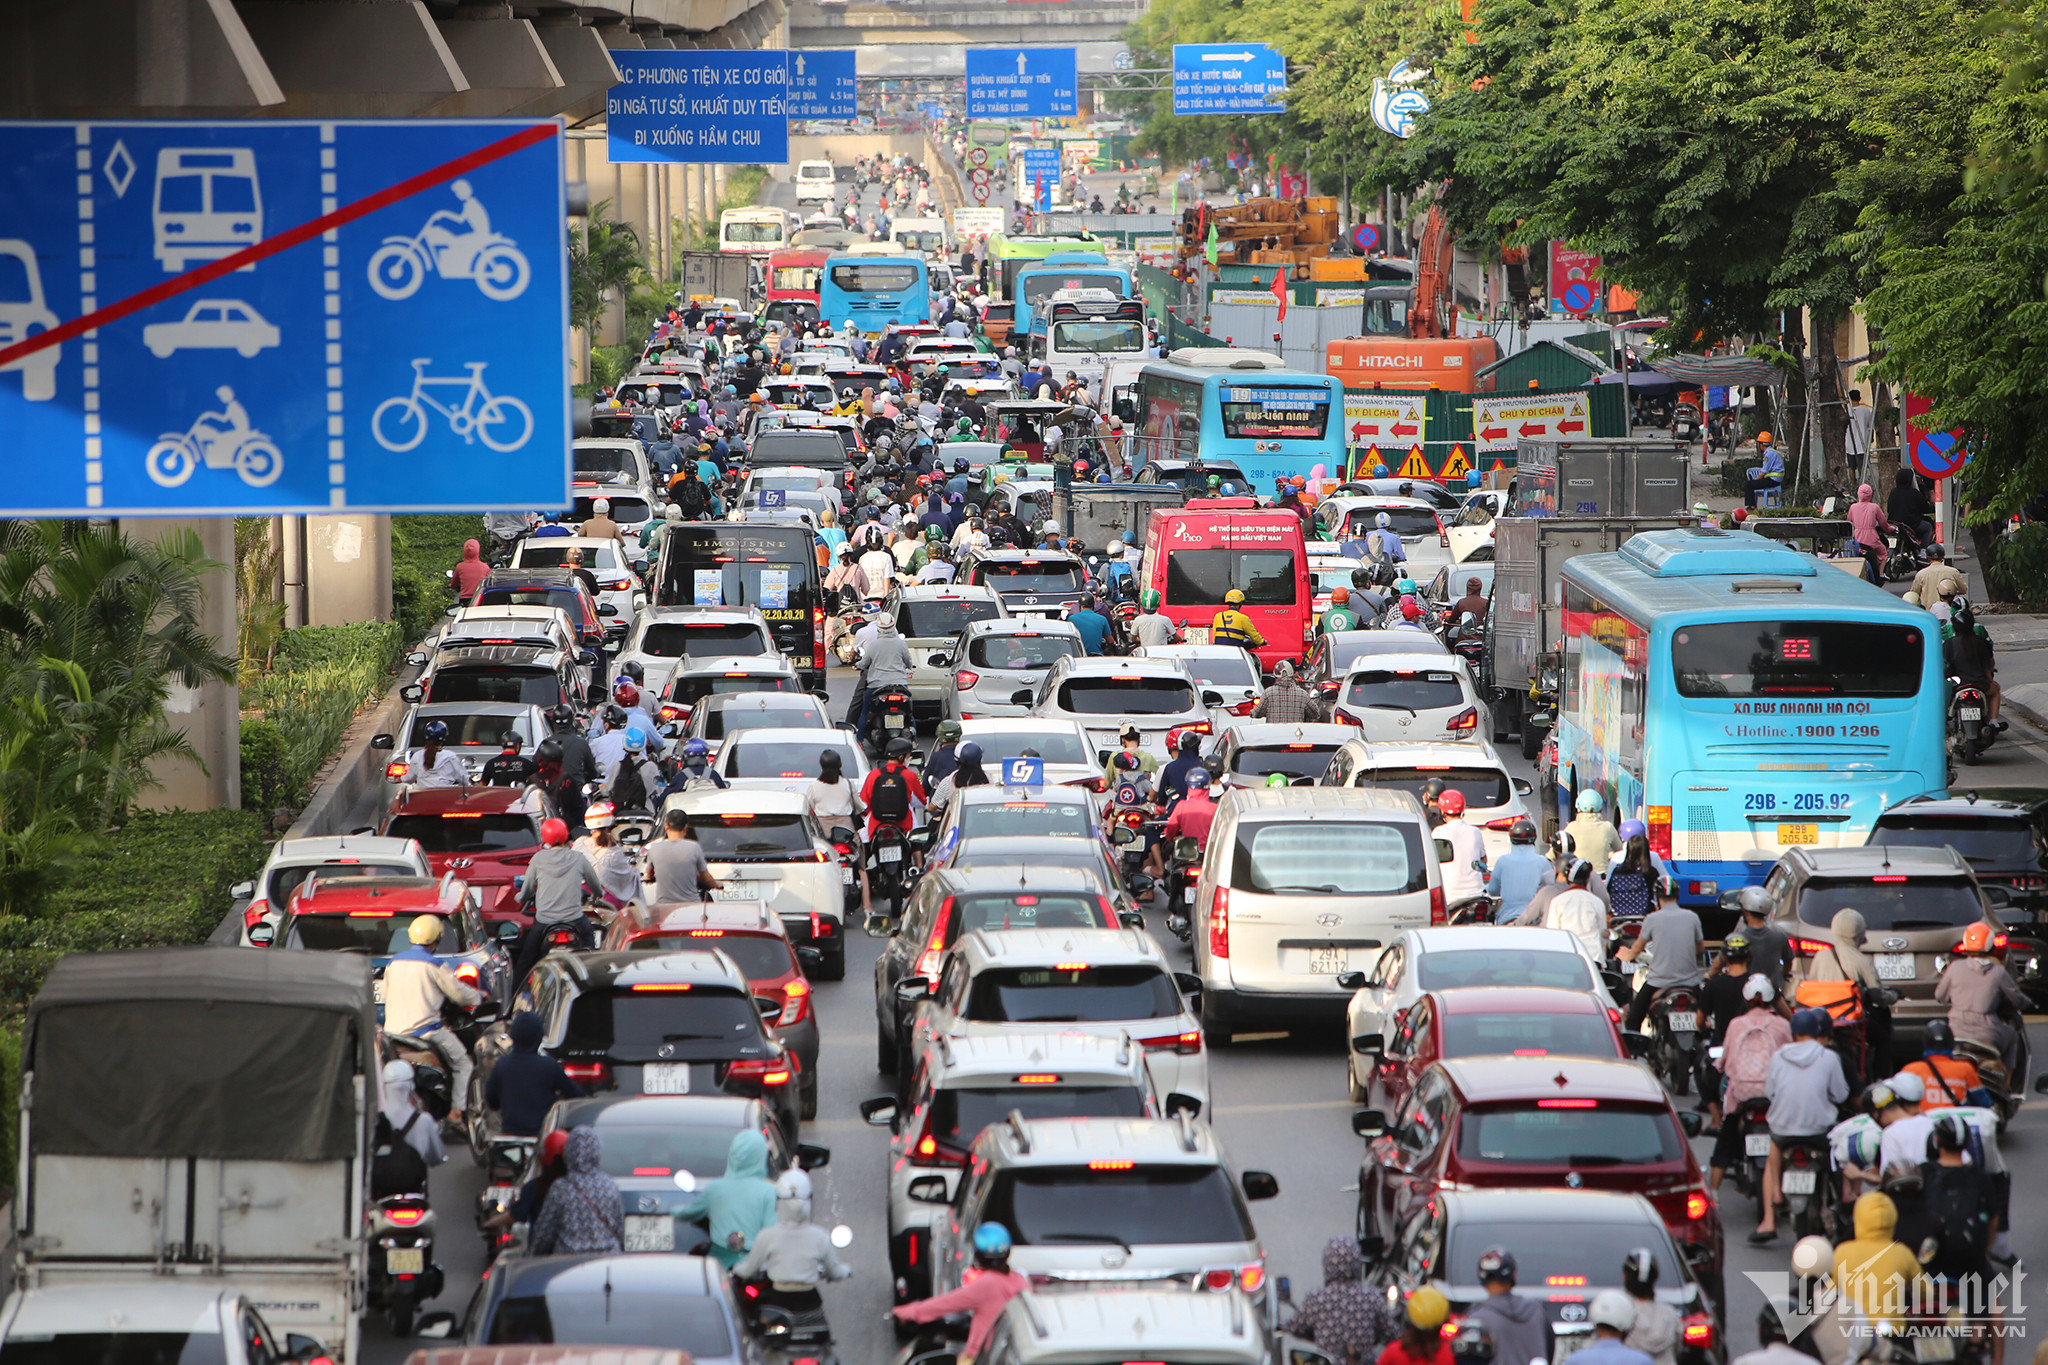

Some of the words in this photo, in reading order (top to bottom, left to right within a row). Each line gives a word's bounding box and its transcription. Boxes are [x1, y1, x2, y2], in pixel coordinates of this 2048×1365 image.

[619, 64, 634, 84] ÁC
[638, 68, 688, 84] PHƯƠNG
[692, 65, 722, 87] TIỆN
[723, 69, 740, 84] XE
[743, 68, 761, 84] CƠ
[764, 64, 786, 85] GIỚI
[1266, 70, 1271, 79] 5
[1272, 70, 1283, 79] km
[843, 77, 854, 86] km
[843, 92, 854, 100] km
[1061, 89, 1072, 97] km
[609, 99, 621, 115] ĐI
[624, 96, 648, 115] NGÃ
[650, 98, 668, 115] TƯ
[669, 94, 688, 116] SỞ,
[692, 94, 729, 115] KHUẤT
[733, 99, 757, 115] DUY
[760, 94, 786, 115] TIẾN
[843, 106, 854, 114] km
[1061, 103, 1072, 111] km
[635, 129, 647, 146] ĐI
[652, 124, 694, 145] XUỐNG
[699, 124, 727, 146] HẦM
[732, 129, 761, 146] CHUI
[1359, 355, 1423, 368] HITACHI
[1362, 408, 1372, 416] ĐI
[1527, 409, 1537, 417] ĐI
[1369, 457, 1378, 466] ĐI
[1576, 502, 1598, 513] 29K
[693, 540, 787, 548] LIMOUSINE
[1733, 702, 1750, 713] XN
[1754, 702, 1776, 713] BUS
[1780, 702, 1822, 713] NHANH
[1827, 700, 1843, 713] HÀ
[1847, 700, 1870, 716] NỘI
[1737, 725, 1787, 737] Hotline
[1840, 725, 1880, 737] 1296
[1012, 760, 1035, 783] G7
[1745, 793, 1776, 809] 29B
[1794, 793, 1850, 810] 205.92
[1789, 825, 1807, 833] 29B
[1782, 835, 1814, 844] 205.92
[1319, 948, 1339, 960] 29A
[1311, 961, 1346, 973] 621.12
[645, 1078, 686, 1093] 811.14
